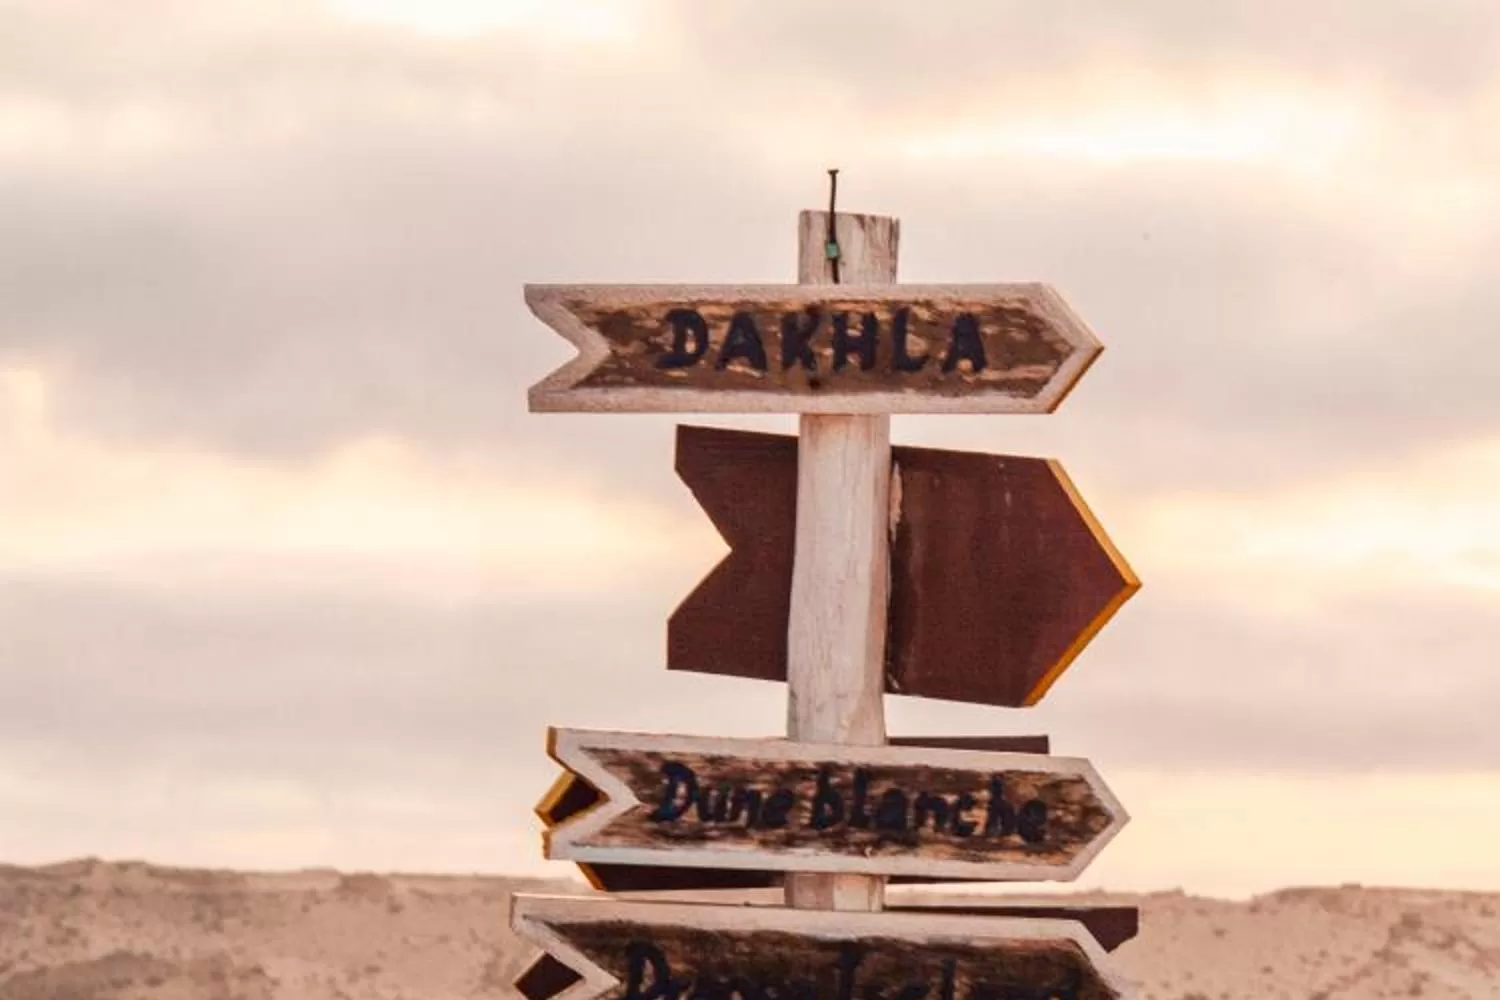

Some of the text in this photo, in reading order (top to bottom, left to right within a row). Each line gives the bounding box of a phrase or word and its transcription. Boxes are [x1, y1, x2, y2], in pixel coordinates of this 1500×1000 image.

[654, 306, 987, 374] DAKHLA
[650, 761, 1046, 842] Dune blanche
